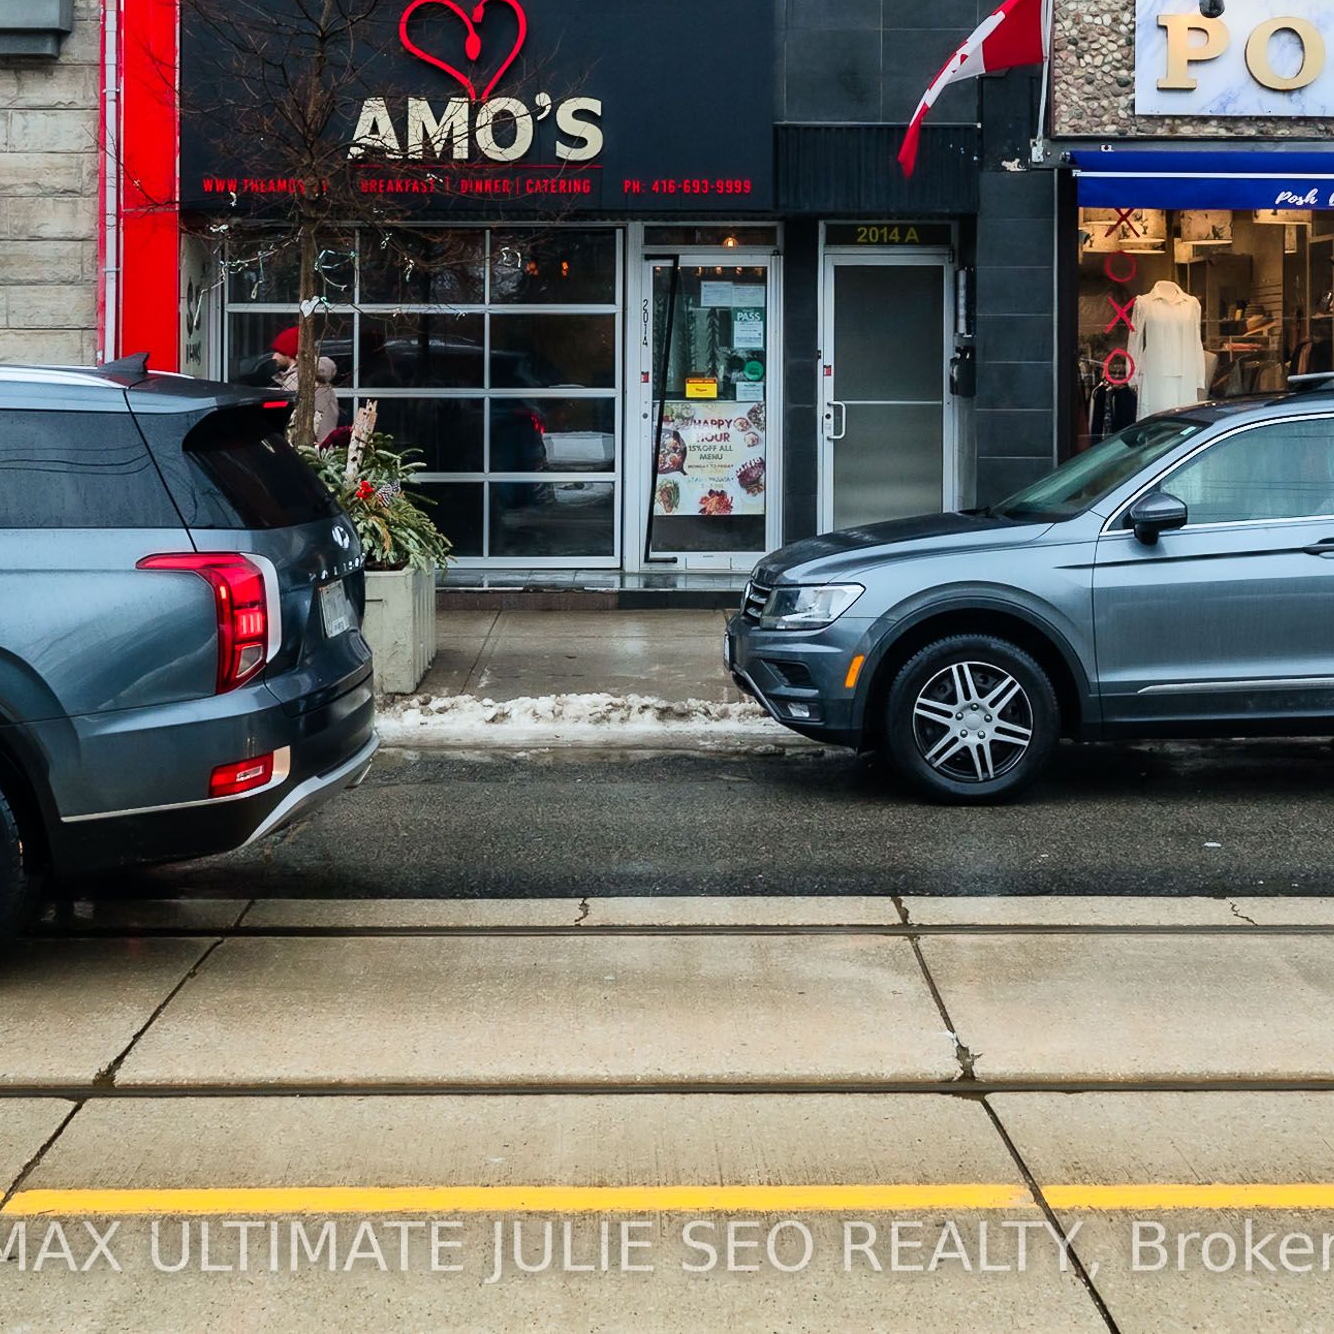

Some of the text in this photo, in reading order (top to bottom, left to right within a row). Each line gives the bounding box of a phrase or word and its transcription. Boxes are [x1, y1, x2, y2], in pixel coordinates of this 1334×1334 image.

[346, 92, 605, 162] AMO'S
[360, 178, 435, 194] BREAKFAST
[525, 179, 591, 194] CATERING
[623, 179, 646, 194] PH:
[652, 179, 752, 194] 416-693-9999
[1275, 188, 1318, 206] Posh
[857, 226, 919, 243] 2014 A
[737, 312, 761, 321] PASS
